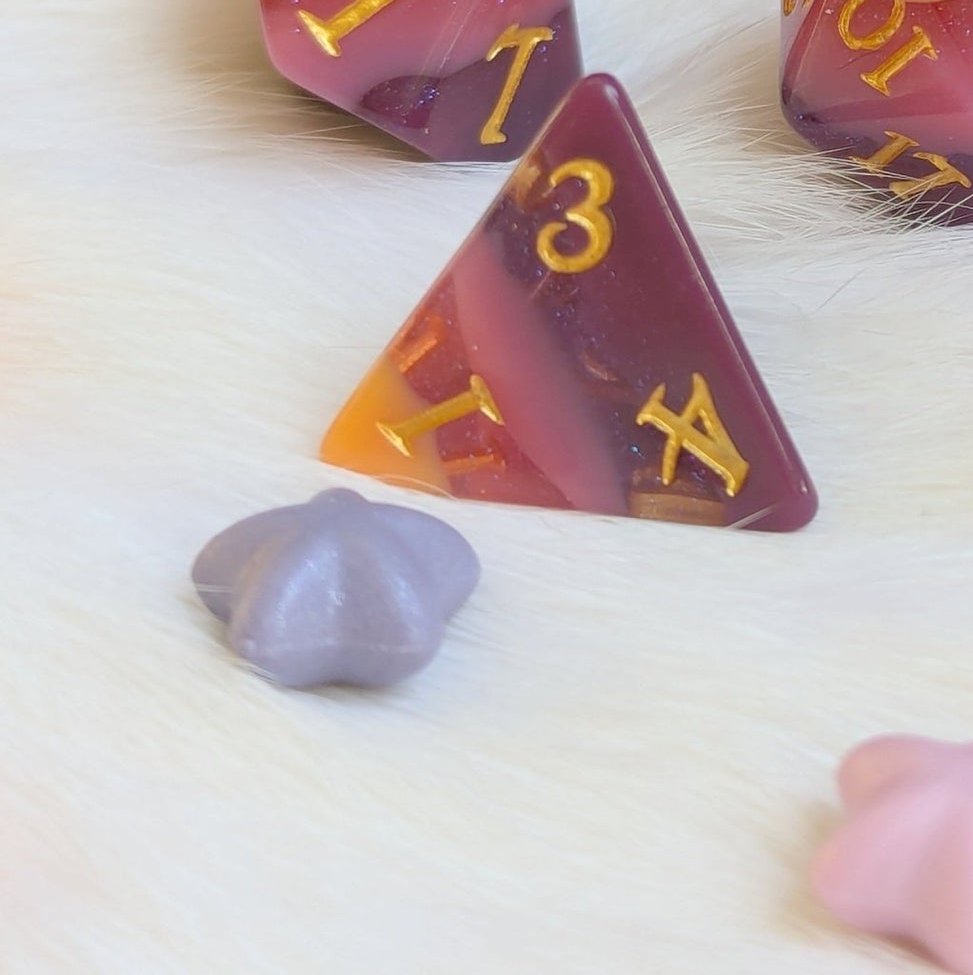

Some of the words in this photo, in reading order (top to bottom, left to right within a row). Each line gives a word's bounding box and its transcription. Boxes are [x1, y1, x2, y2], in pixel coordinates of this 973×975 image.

[537, 157, 614, 274] 3
[376, 375, 505, 457] 1
[636, 372, 750, 497] 4
